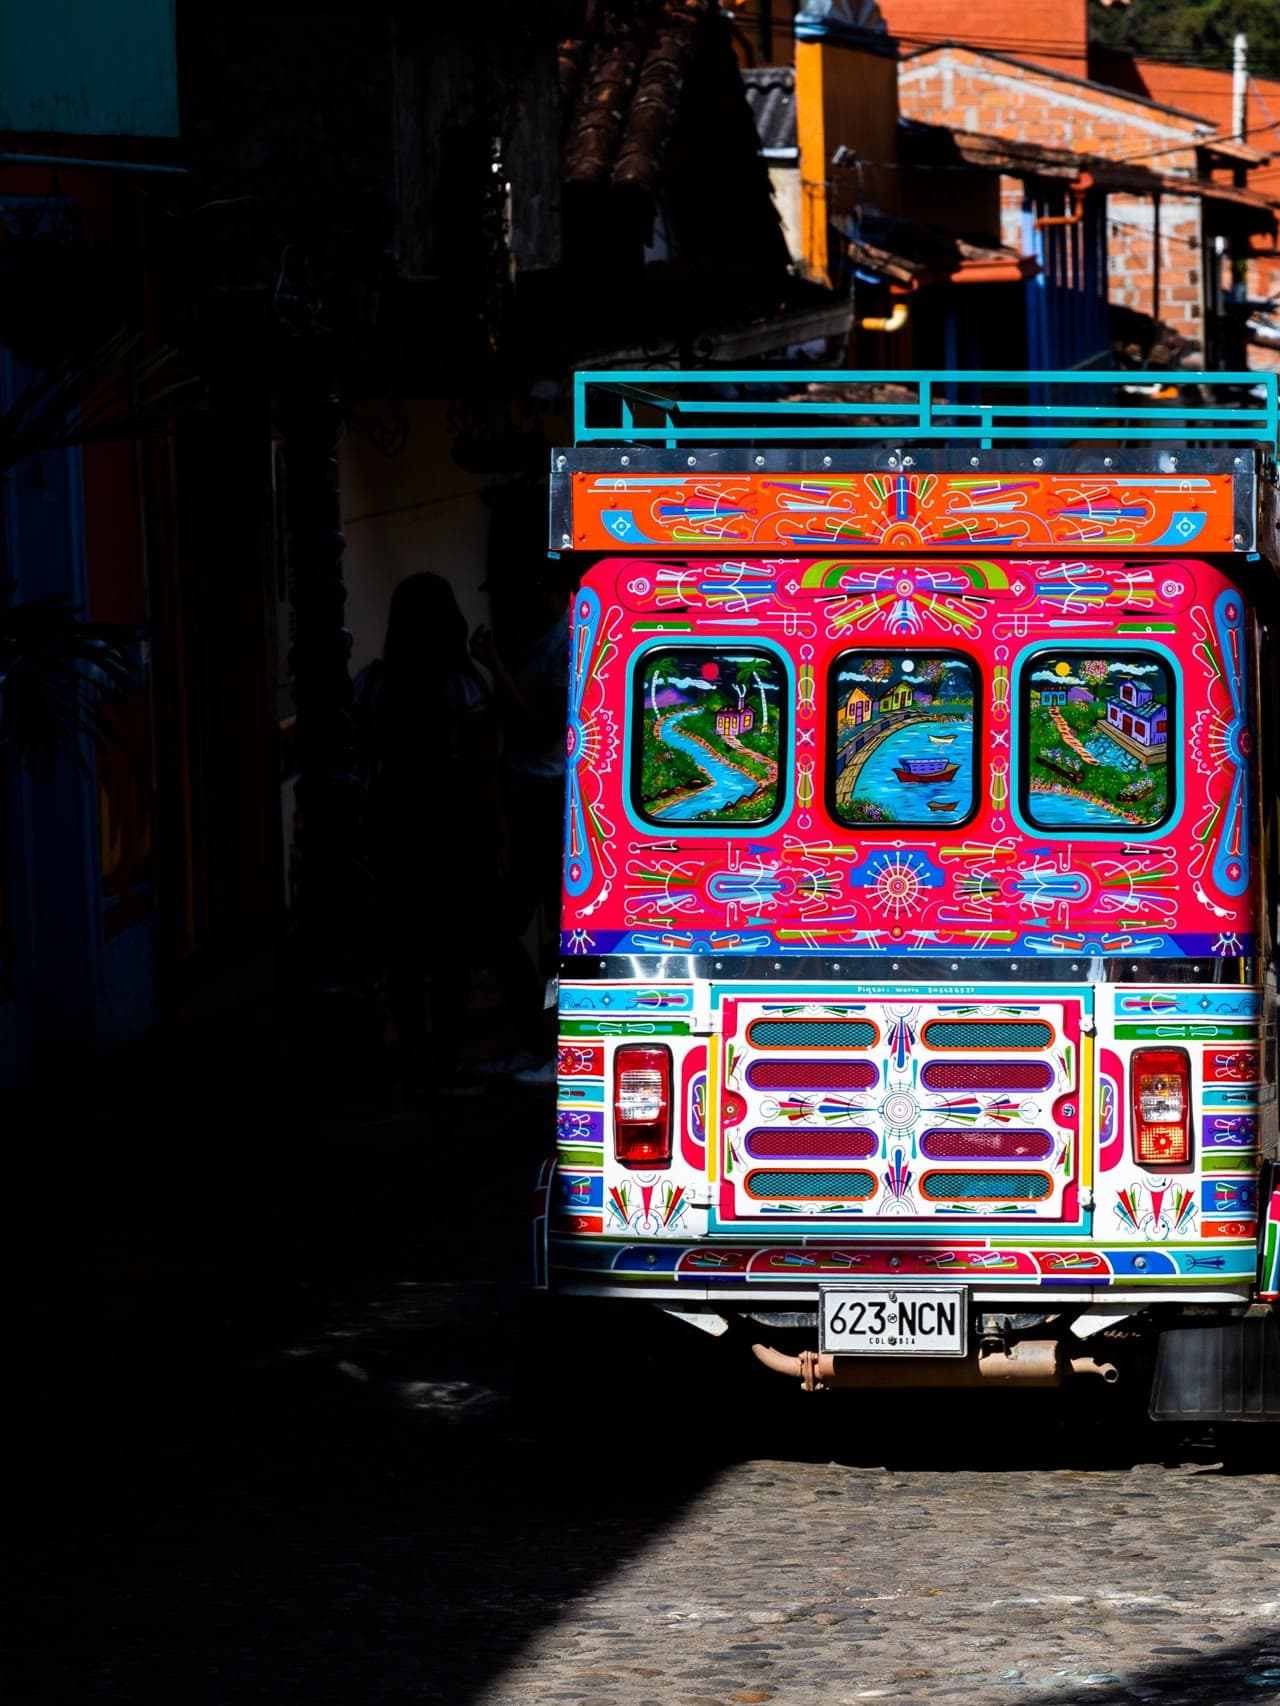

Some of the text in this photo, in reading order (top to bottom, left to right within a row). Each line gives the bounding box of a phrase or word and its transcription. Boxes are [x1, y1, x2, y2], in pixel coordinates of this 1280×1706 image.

[830, 1302, 955, 1336] 623 NCN
[869, 1337, 915, 1345] COLBIA
